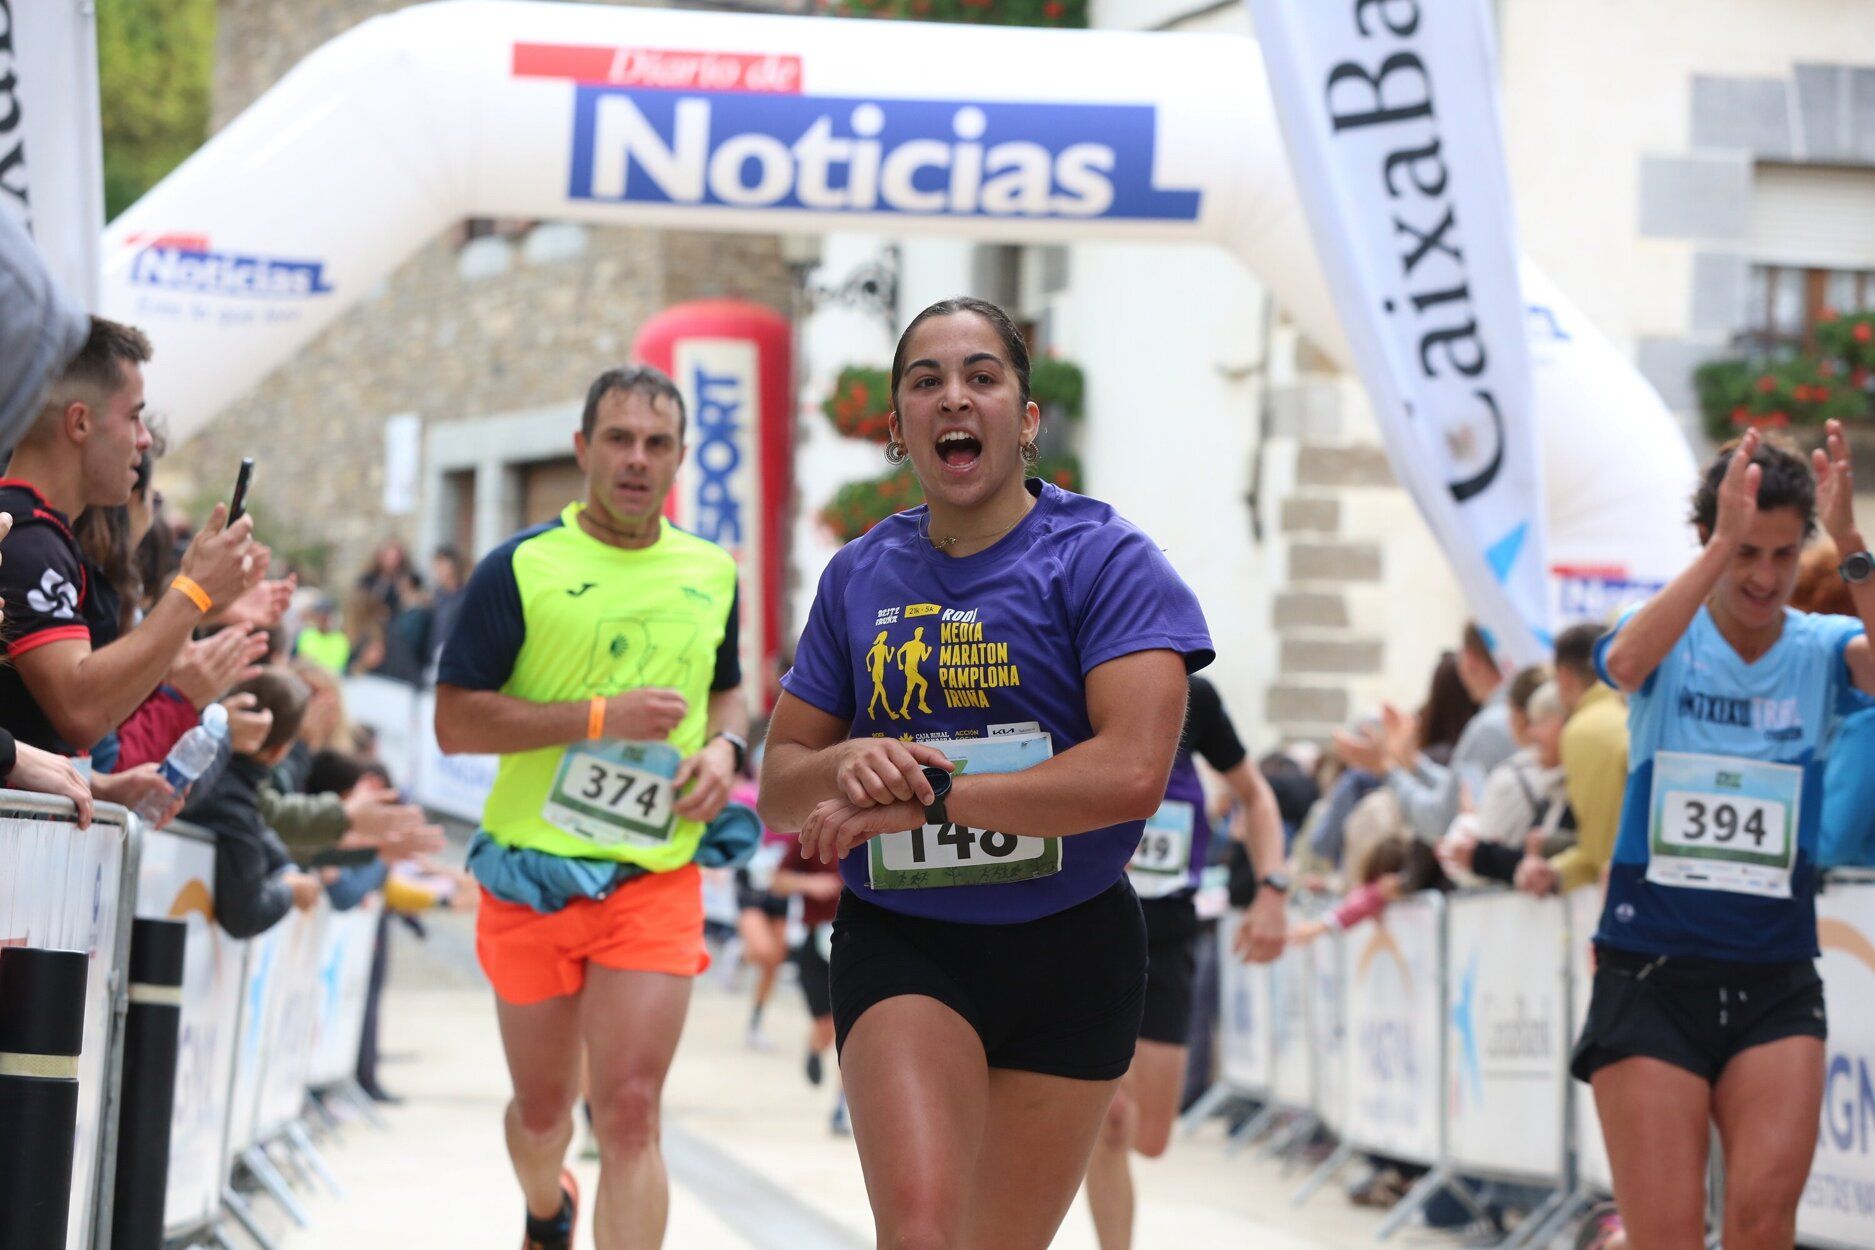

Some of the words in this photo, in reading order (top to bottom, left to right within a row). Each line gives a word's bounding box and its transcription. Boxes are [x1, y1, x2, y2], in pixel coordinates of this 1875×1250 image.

[609, 48, 742, 91] Diario
[745, 54, 799, 92] de
[591, 95, 1115, 217] Noticias
[140, 248, 311, 293] Noticias
[939, 642, 1008, 666] MARATON
[940, 622, 983, 644] MEDIA
[938, 665, 1020, 689] PAMPLONA
[943, 689, 990, 708] IRUÑA
[582, 764, 659, 817] 374
[1683, 800, 1767, 847] 394
